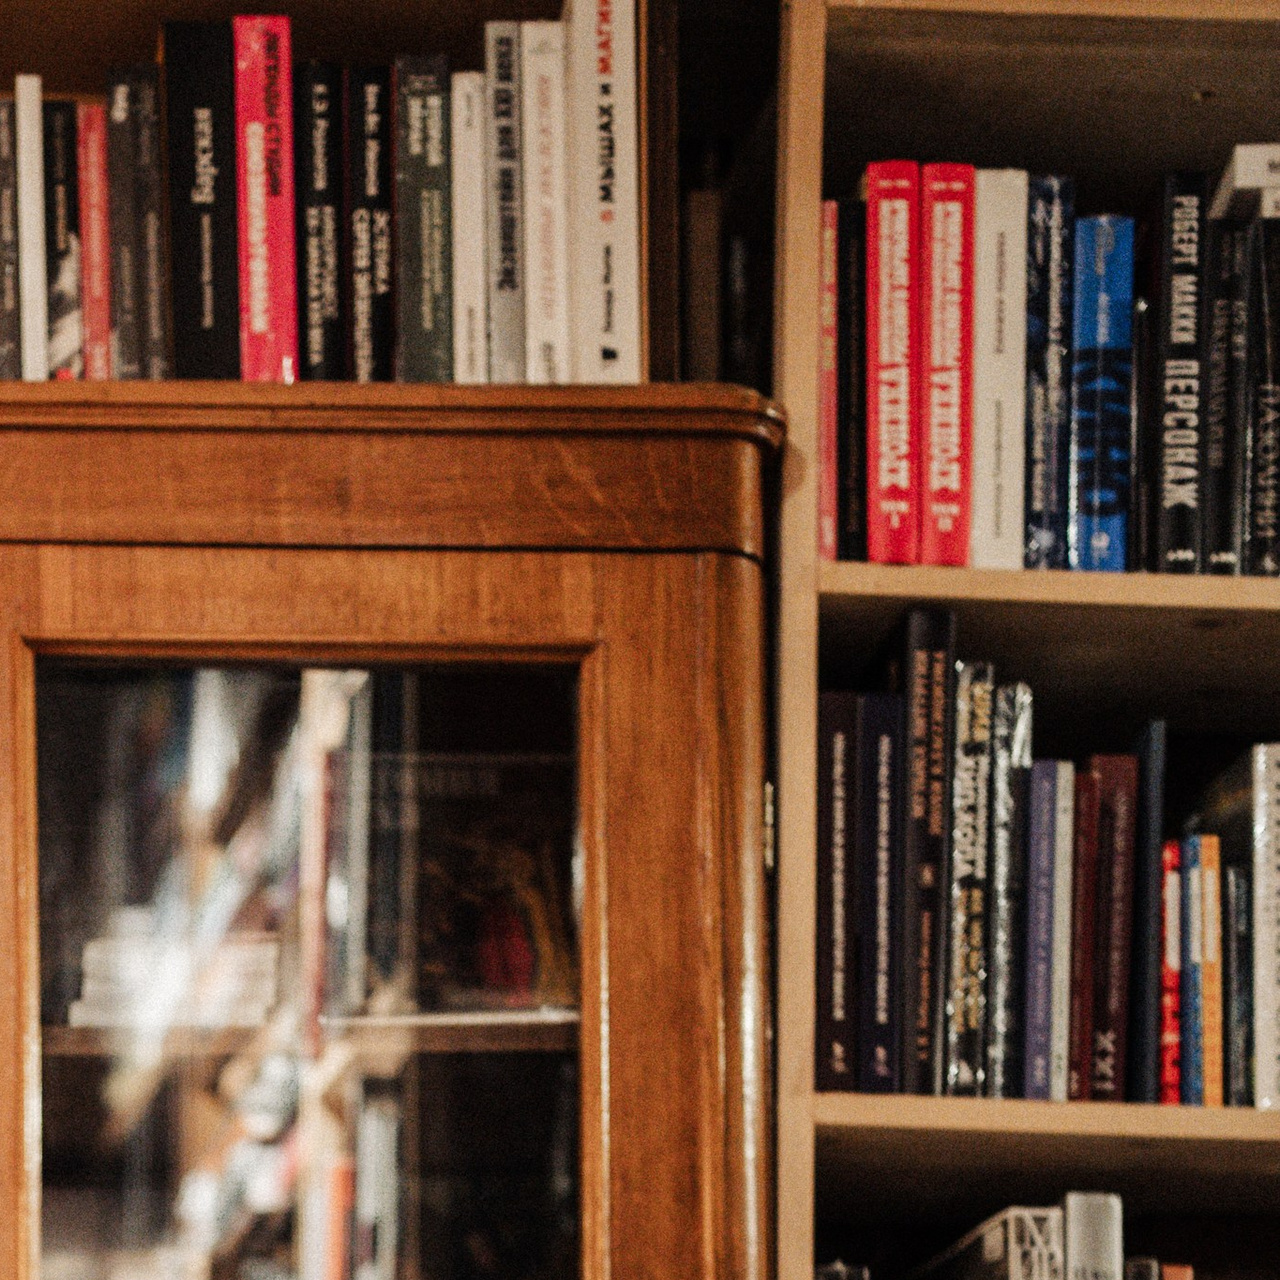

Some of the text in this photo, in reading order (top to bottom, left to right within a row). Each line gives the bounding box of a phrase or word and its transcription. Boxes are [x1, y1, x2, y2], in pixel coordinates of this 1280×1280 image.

[599, 105, 615, 203] МЫШАХ
[1164, 195, 1199, 509] РОБЕРТ МАККИ ПЕРСОНАЖ
